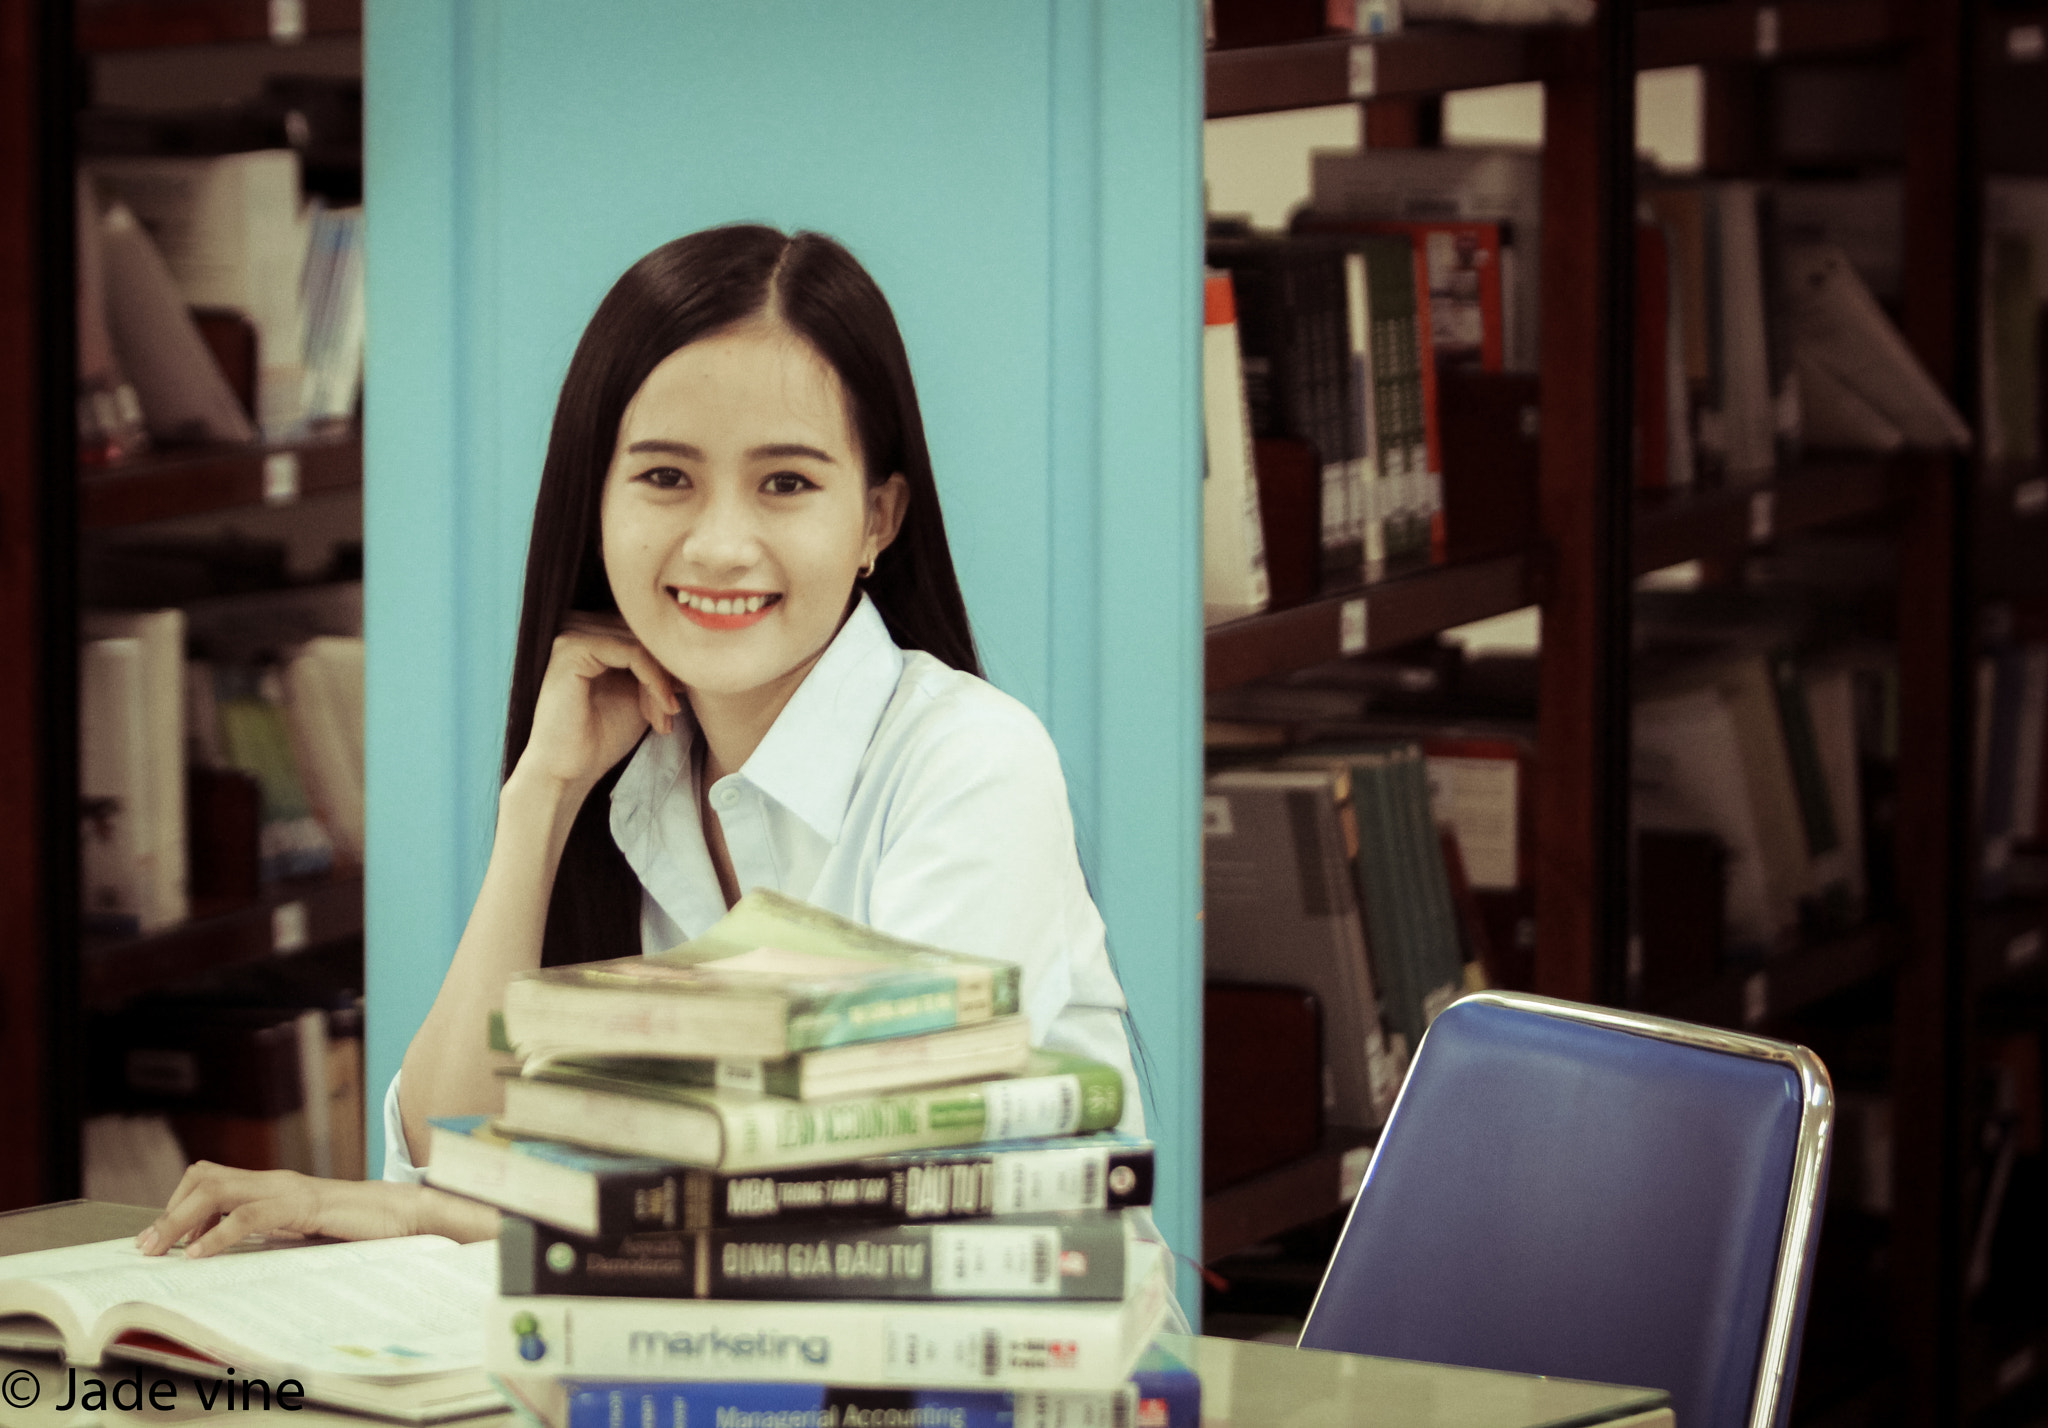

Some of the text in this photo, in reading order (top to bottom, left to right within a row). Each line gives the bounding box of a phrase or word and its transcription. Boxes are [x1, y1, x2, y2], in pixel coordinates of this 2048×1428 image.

[727, 1177, 776, 1216] MBA
[628, 1325, 829, 1365] marketing
[842, 1403, 967, 1428] Accounting
